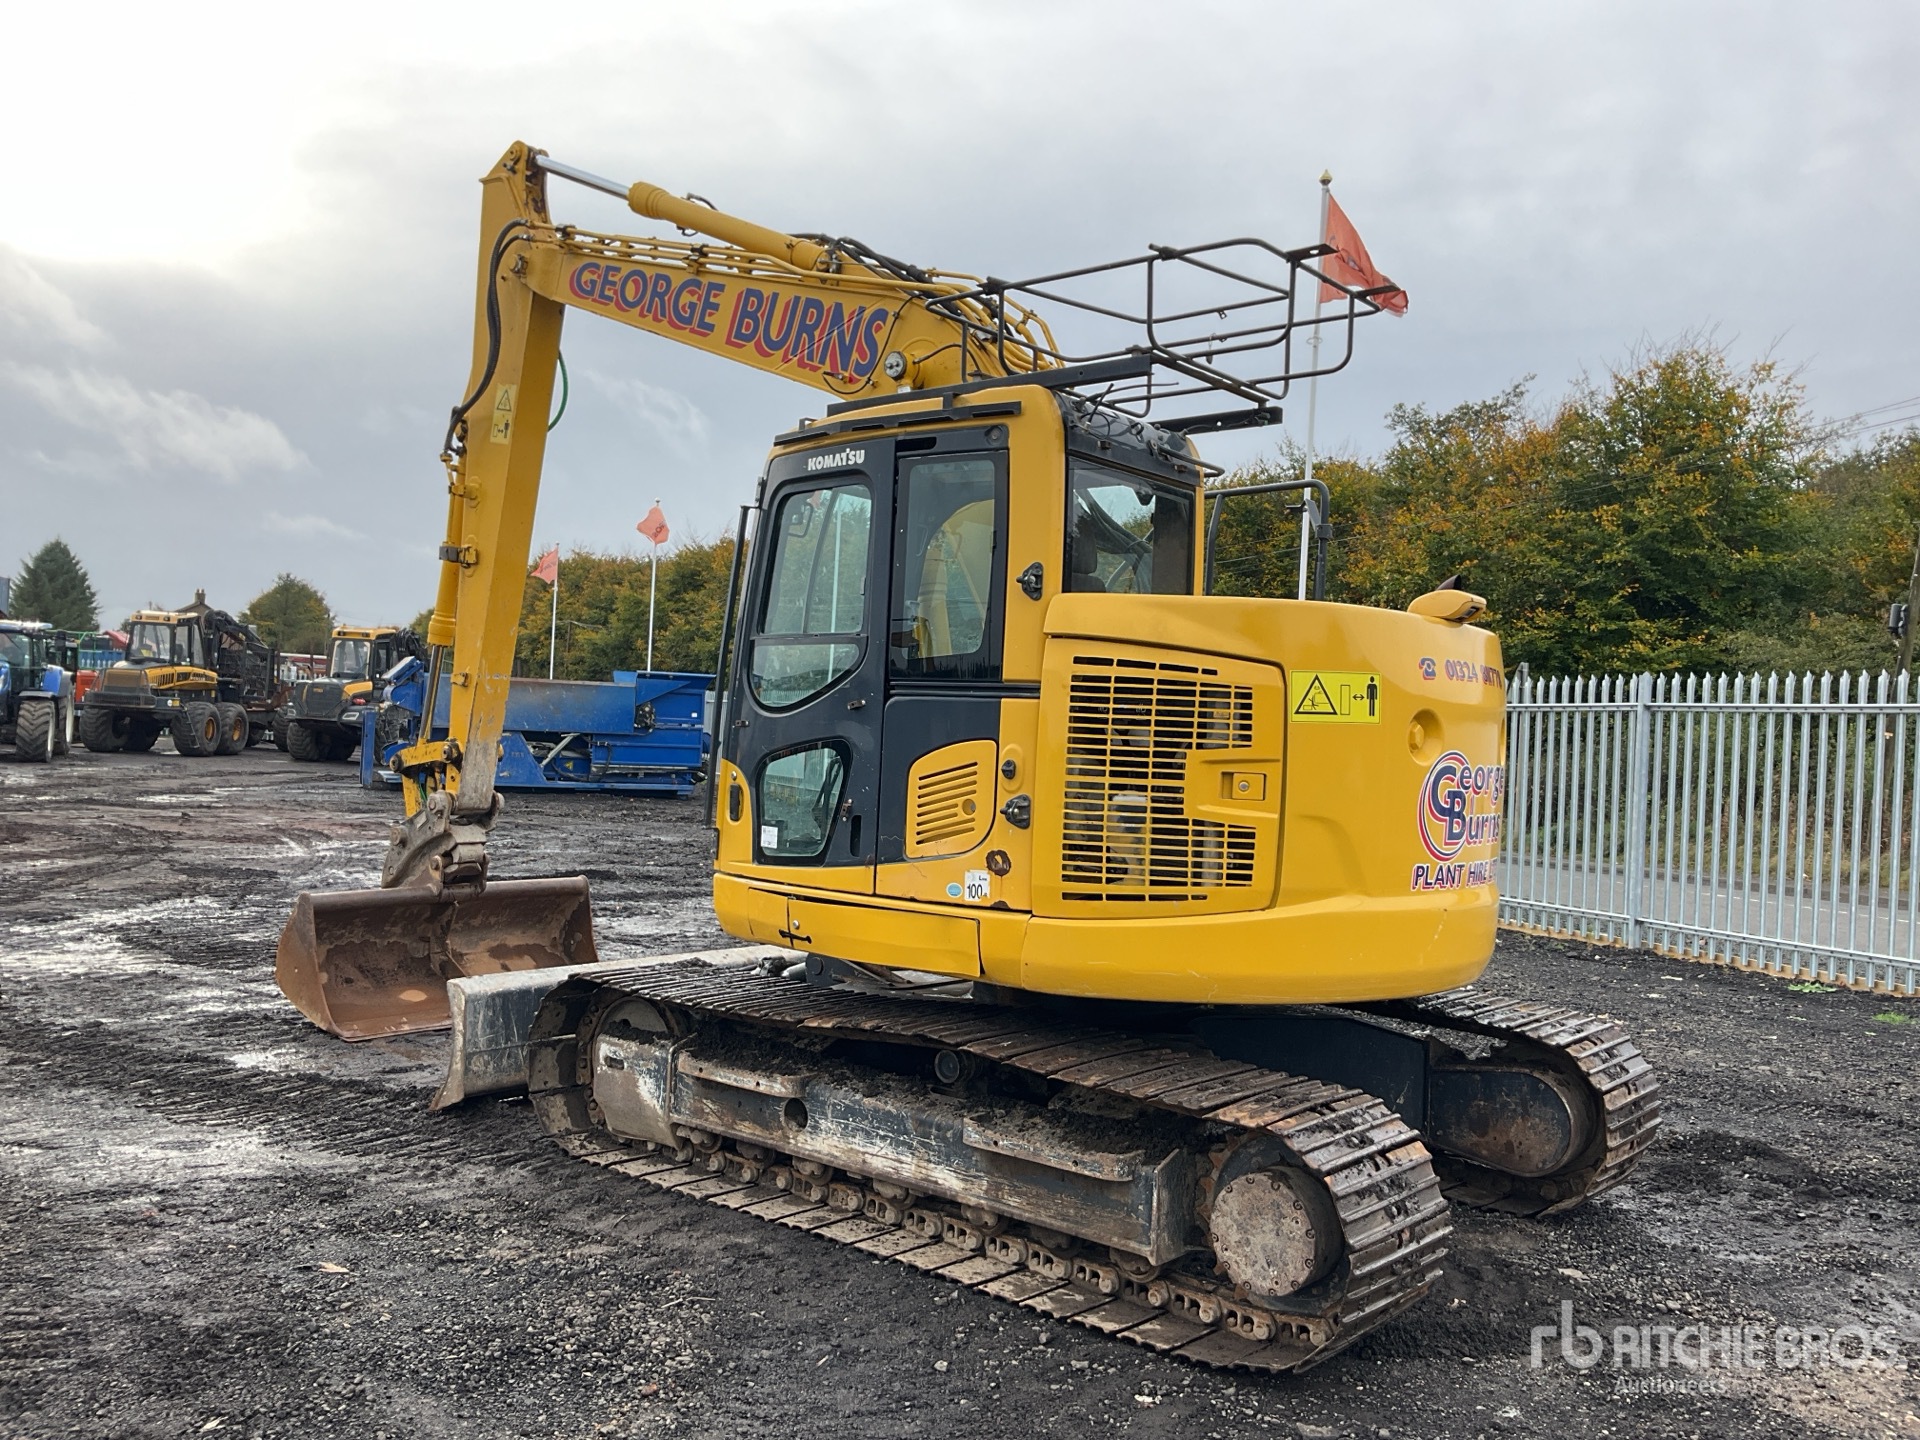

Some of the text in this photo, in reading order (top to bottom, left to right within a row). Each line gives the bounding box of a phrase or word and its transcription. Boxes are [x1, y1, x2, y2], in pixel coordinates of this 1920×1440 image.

[570, 261, 889, 384] GEORGE BURNS
[807, 448, 865, 471] KOMATSU
[1412, 864, 1465, 890] PLANT
[1466, 861, 1489, 886] HIRE
[966, 883, 983, 899] 100
